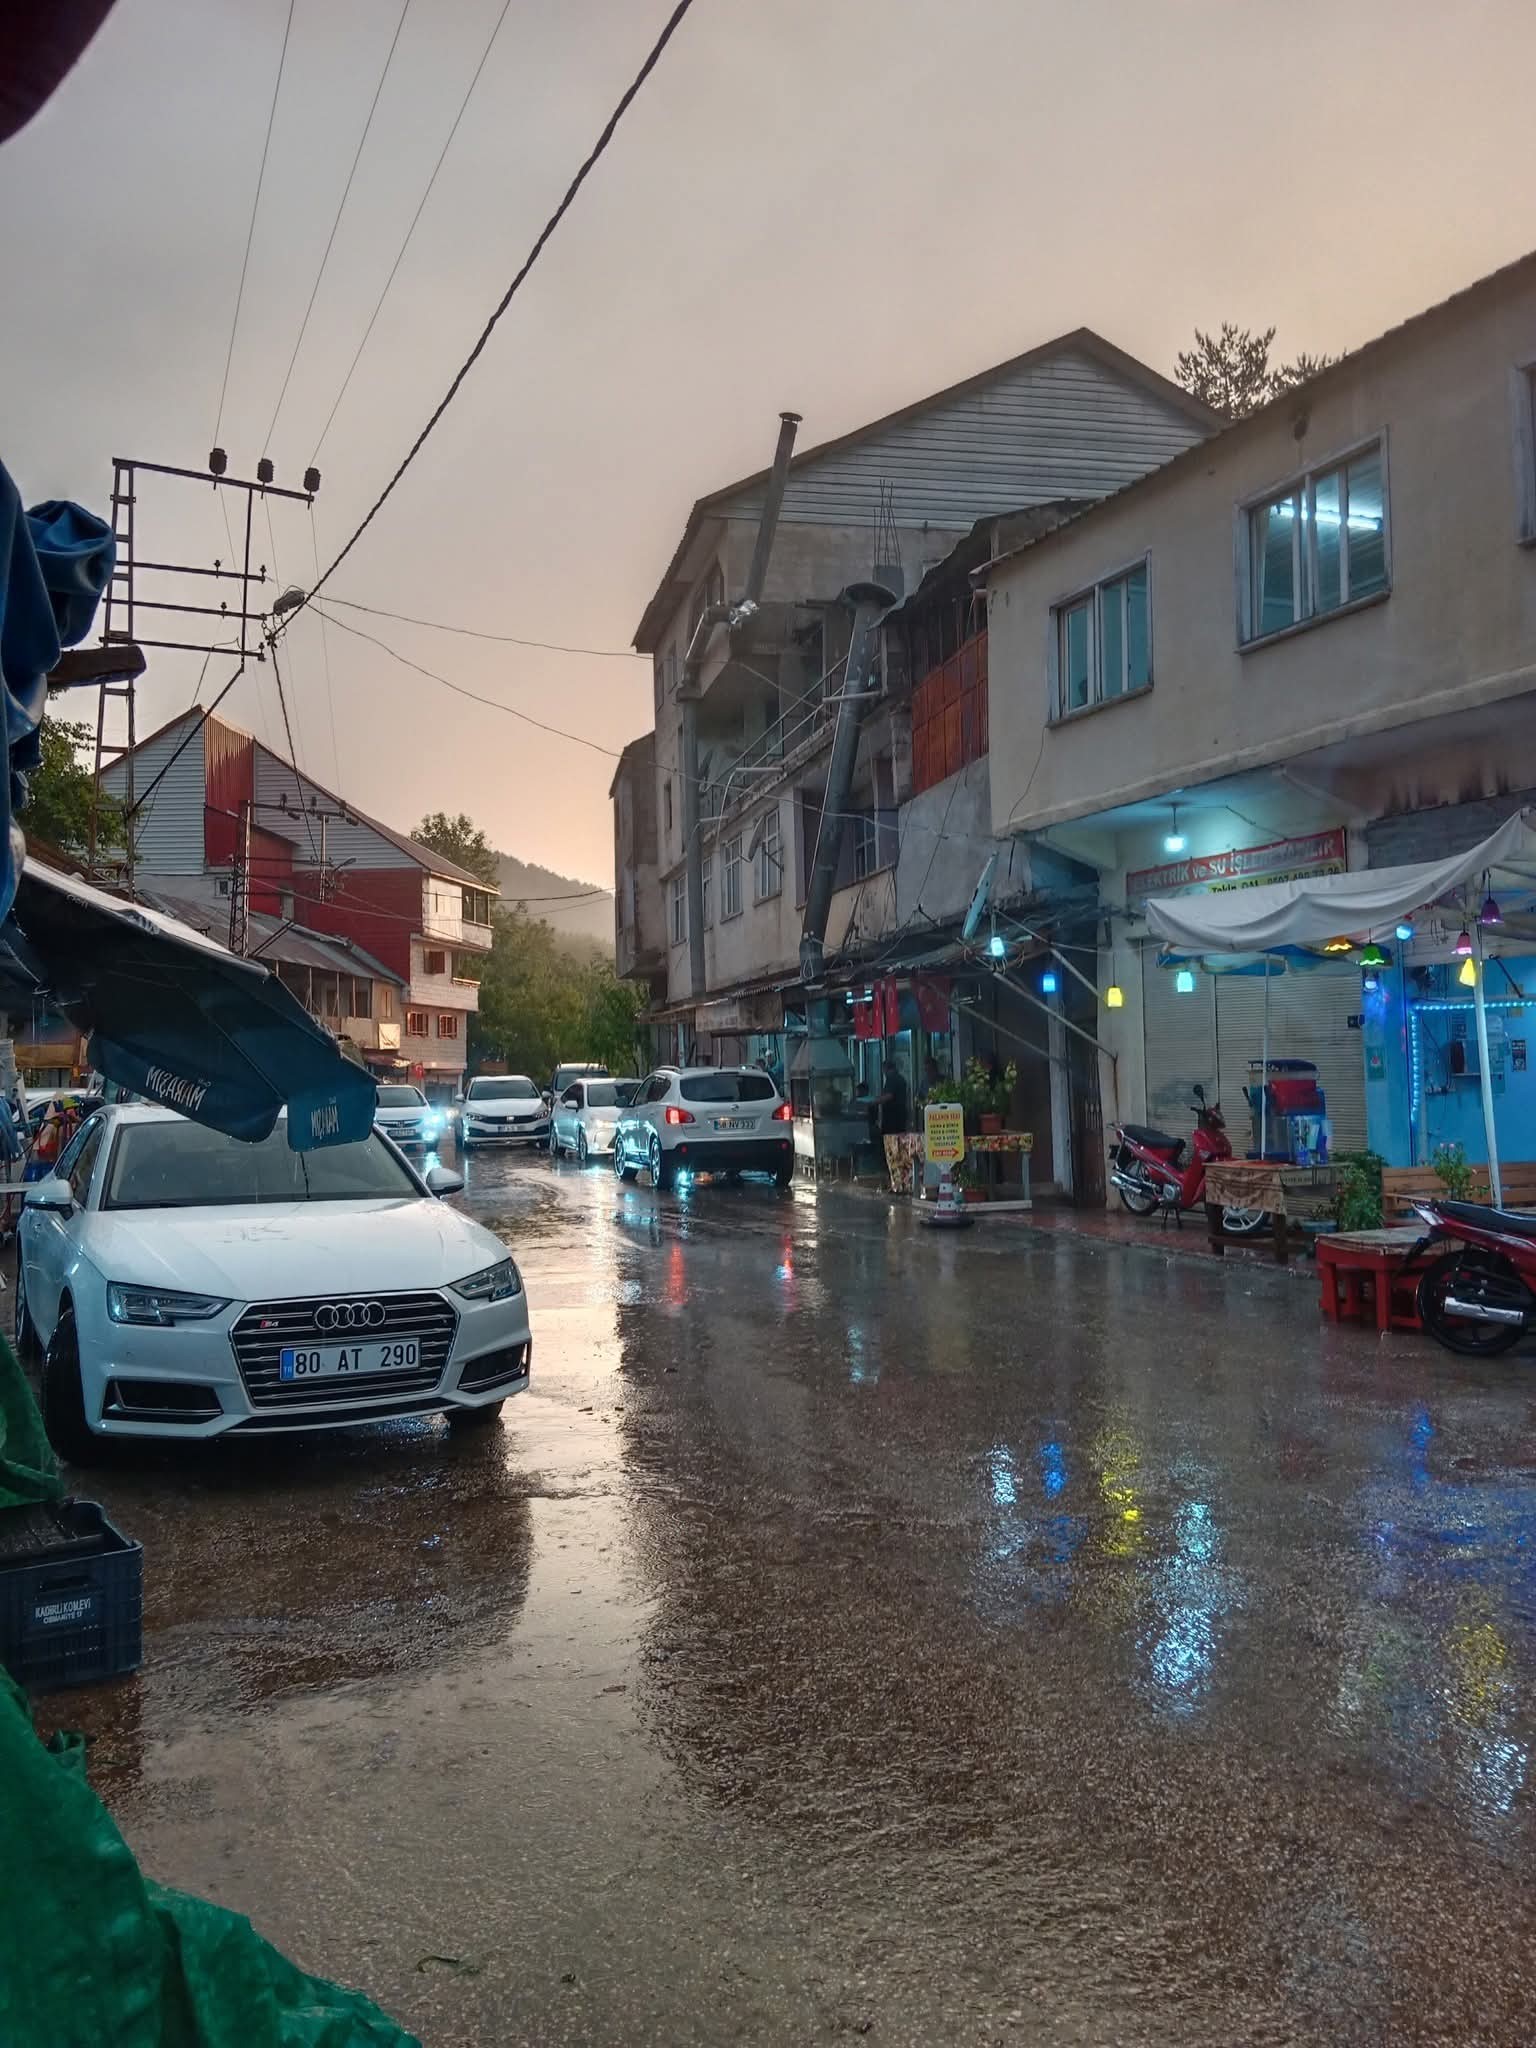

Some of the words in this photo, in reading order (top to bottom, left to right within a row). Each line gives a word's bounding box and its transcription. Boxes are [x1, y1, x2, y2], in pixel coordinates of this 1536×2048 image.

[1192, 864, 1207, 879] ve
[1208, 857, 1226, 875] SU
[295, 1351, 321, 1374] 80
[337, 1348, 363, 1371] AT
[380, 1343, 416, 1367] 290
